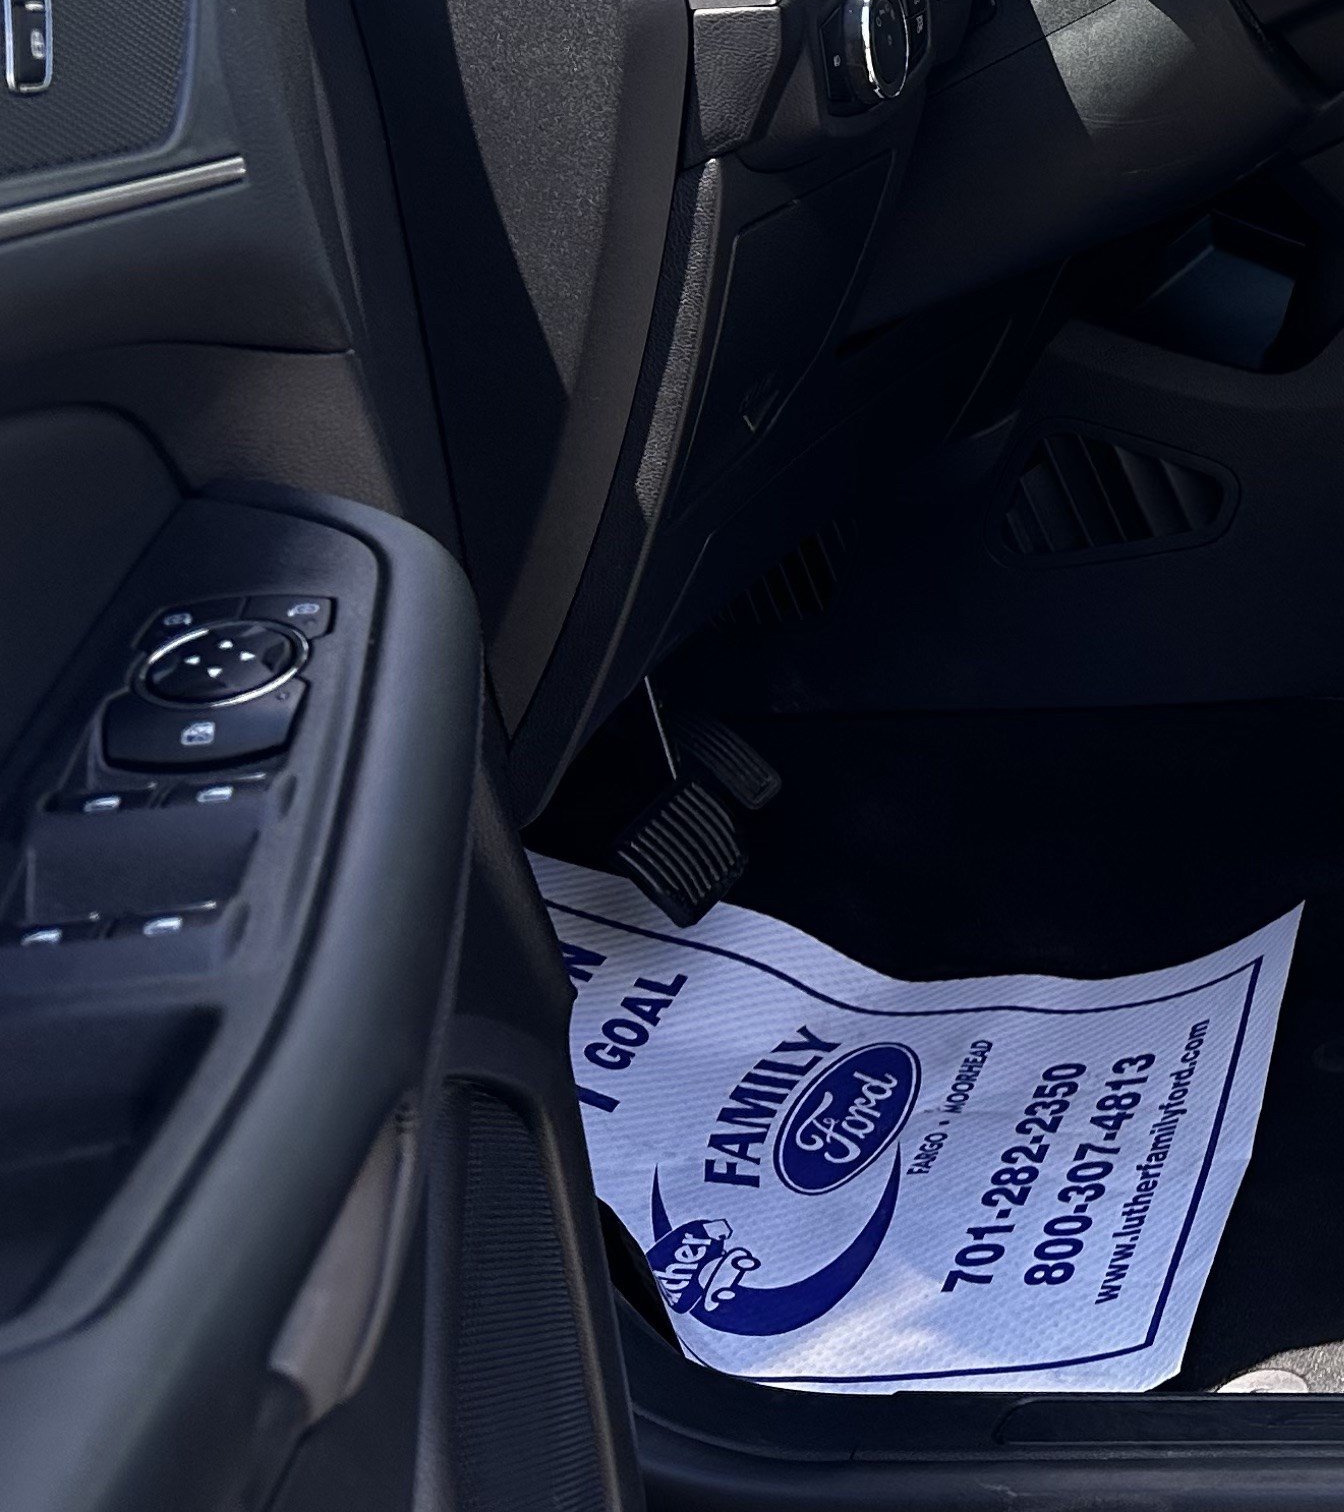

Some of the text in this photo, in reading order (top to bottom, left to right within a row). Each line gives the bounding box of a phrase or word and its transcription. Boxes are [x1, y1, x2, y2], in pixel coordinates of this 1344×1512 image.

[584, 973, 689, 1070] GOAL
[704, 1025, 843, 1188] FAMILY
[796, 1070, 898, 1164] Ford
[906, 1039, 993, 1176] FARGO MOORHEAD
[940, 1062, 1087, 1293] 701-282-2350
[1023, 1053, 1156, 1286] 800-307-4813
[1095, 1018, 1210, 1305] www.lutherfamilyford.com
